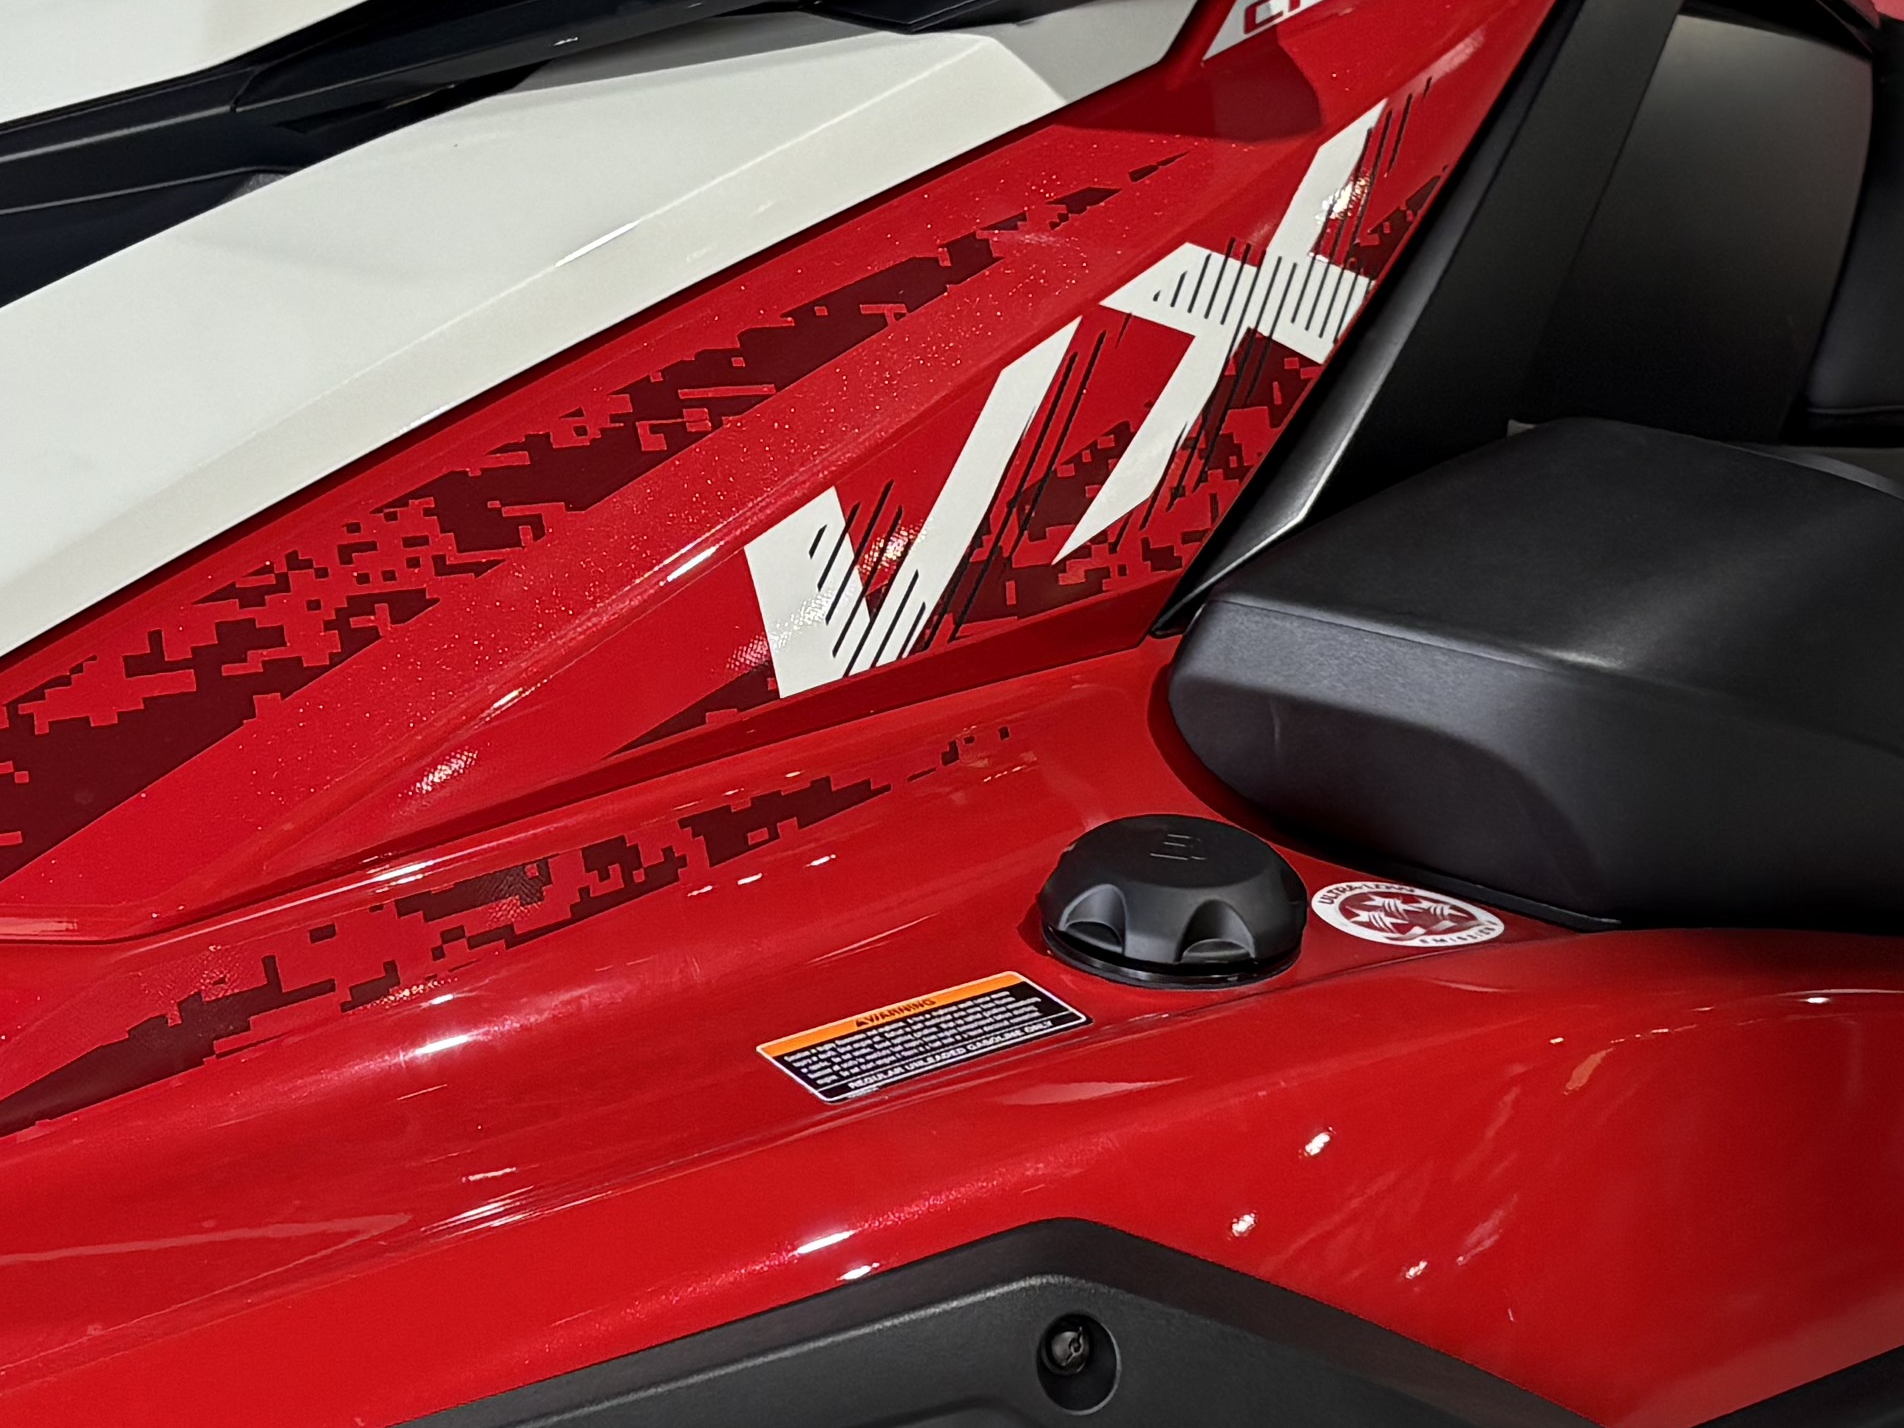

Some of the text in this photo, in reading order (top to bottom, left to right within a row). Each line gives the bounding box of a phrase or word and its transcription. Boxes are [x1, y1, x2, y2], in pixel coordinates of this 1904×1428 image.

[743, 98, 1389, 699] VX
[847, 1019, 1054, 1090] REGULAR UNLEADED GASOLINE ONLY
